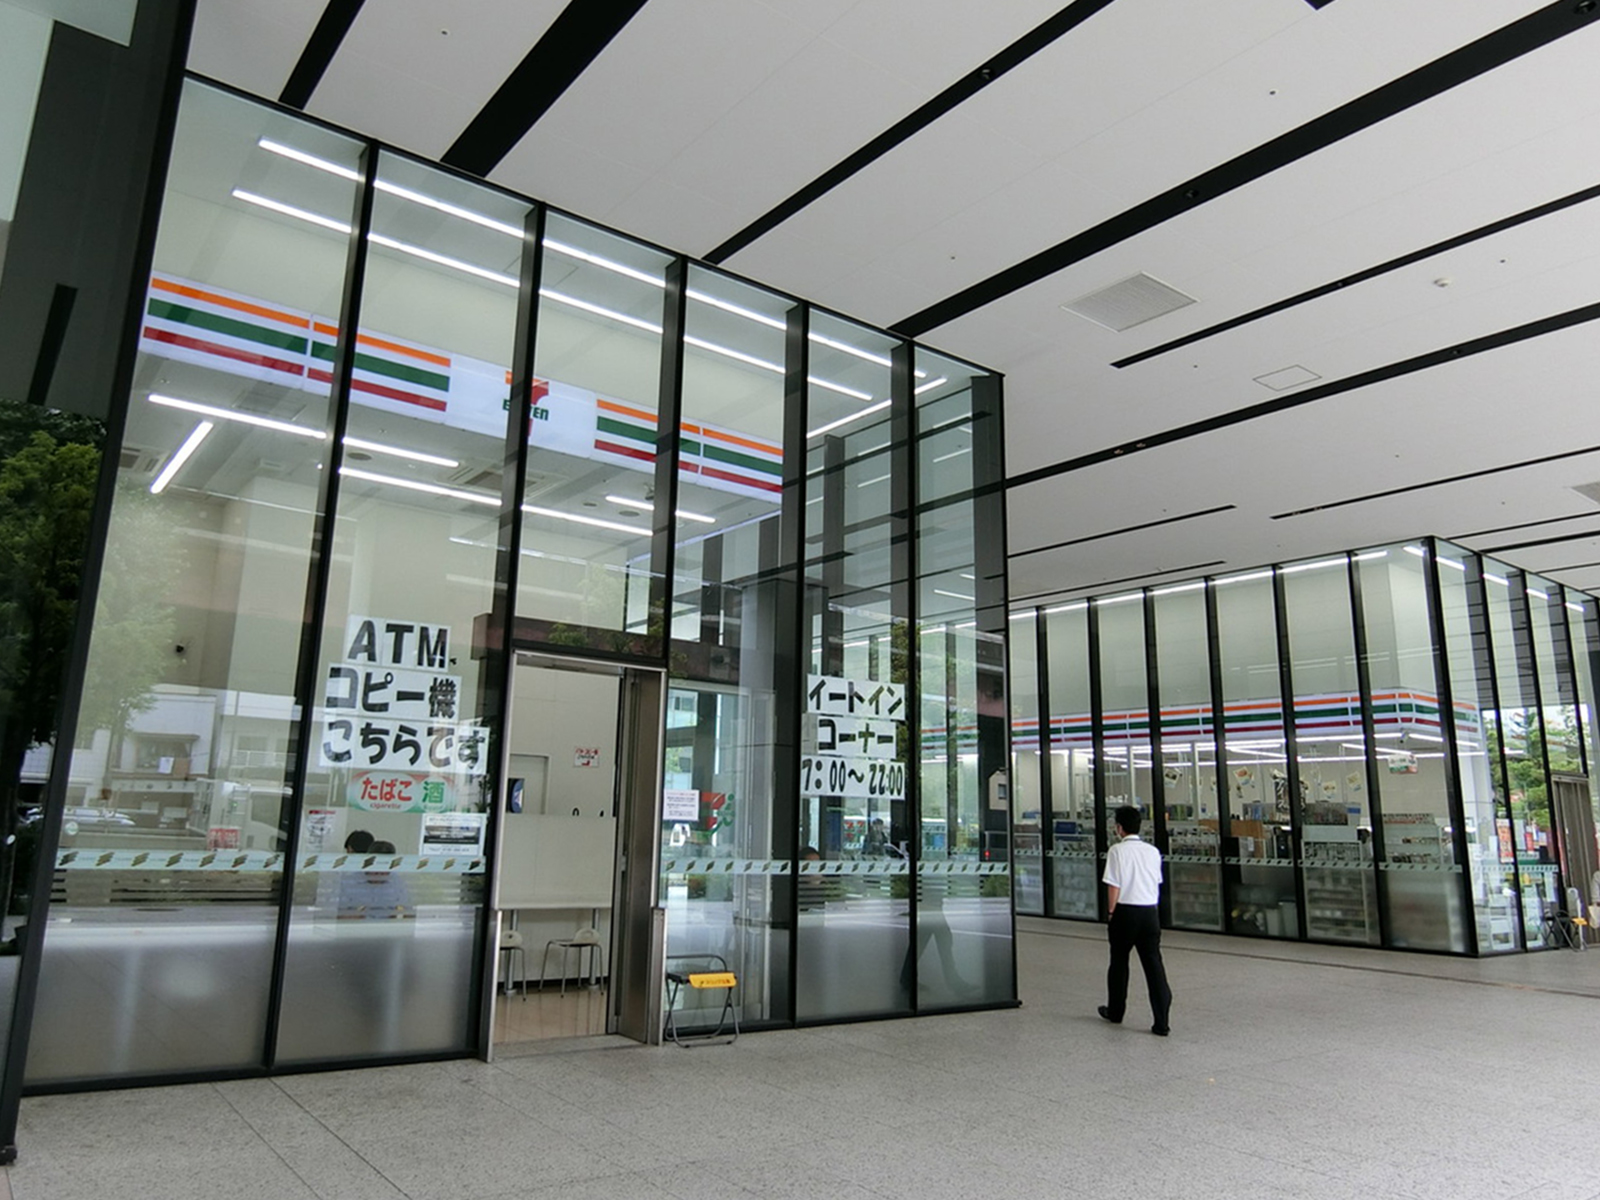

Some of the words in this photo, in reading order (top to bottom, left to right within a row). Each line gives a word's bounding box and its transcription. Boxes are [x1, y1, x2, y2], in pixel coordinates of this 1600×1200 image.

[326, 666, 457, 719] コピー機
[808, 679, 903, 715] イートイン
[323, 719, 485, 770] こちらです
[818, 719, 894, 753] コーナー
[361, 777, 412, 801] たばこ
[422, 781, 445, 803] 酒
